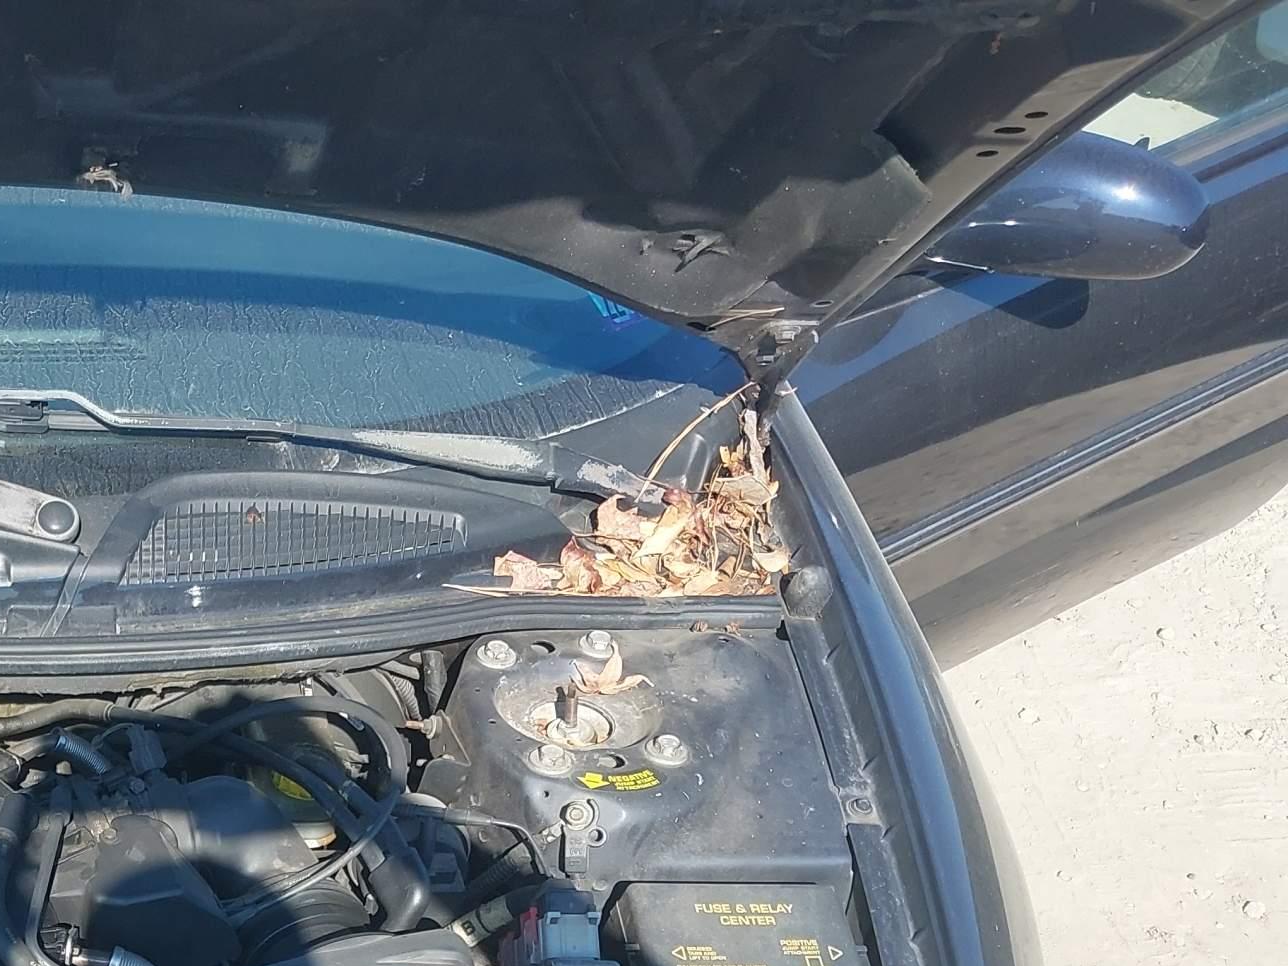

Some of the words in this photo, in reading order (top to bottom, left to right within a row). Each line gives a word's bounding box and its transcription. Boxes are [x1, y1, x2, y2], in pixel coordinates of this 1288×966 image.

[608, 769, 654, 782] NEGATIVE
[695, 903, 731, 914] FUSE
[735, 904, 747, 914] &
[750, 903, 793, 914] RELAY
[719, 915, 776, 926] CENTER
